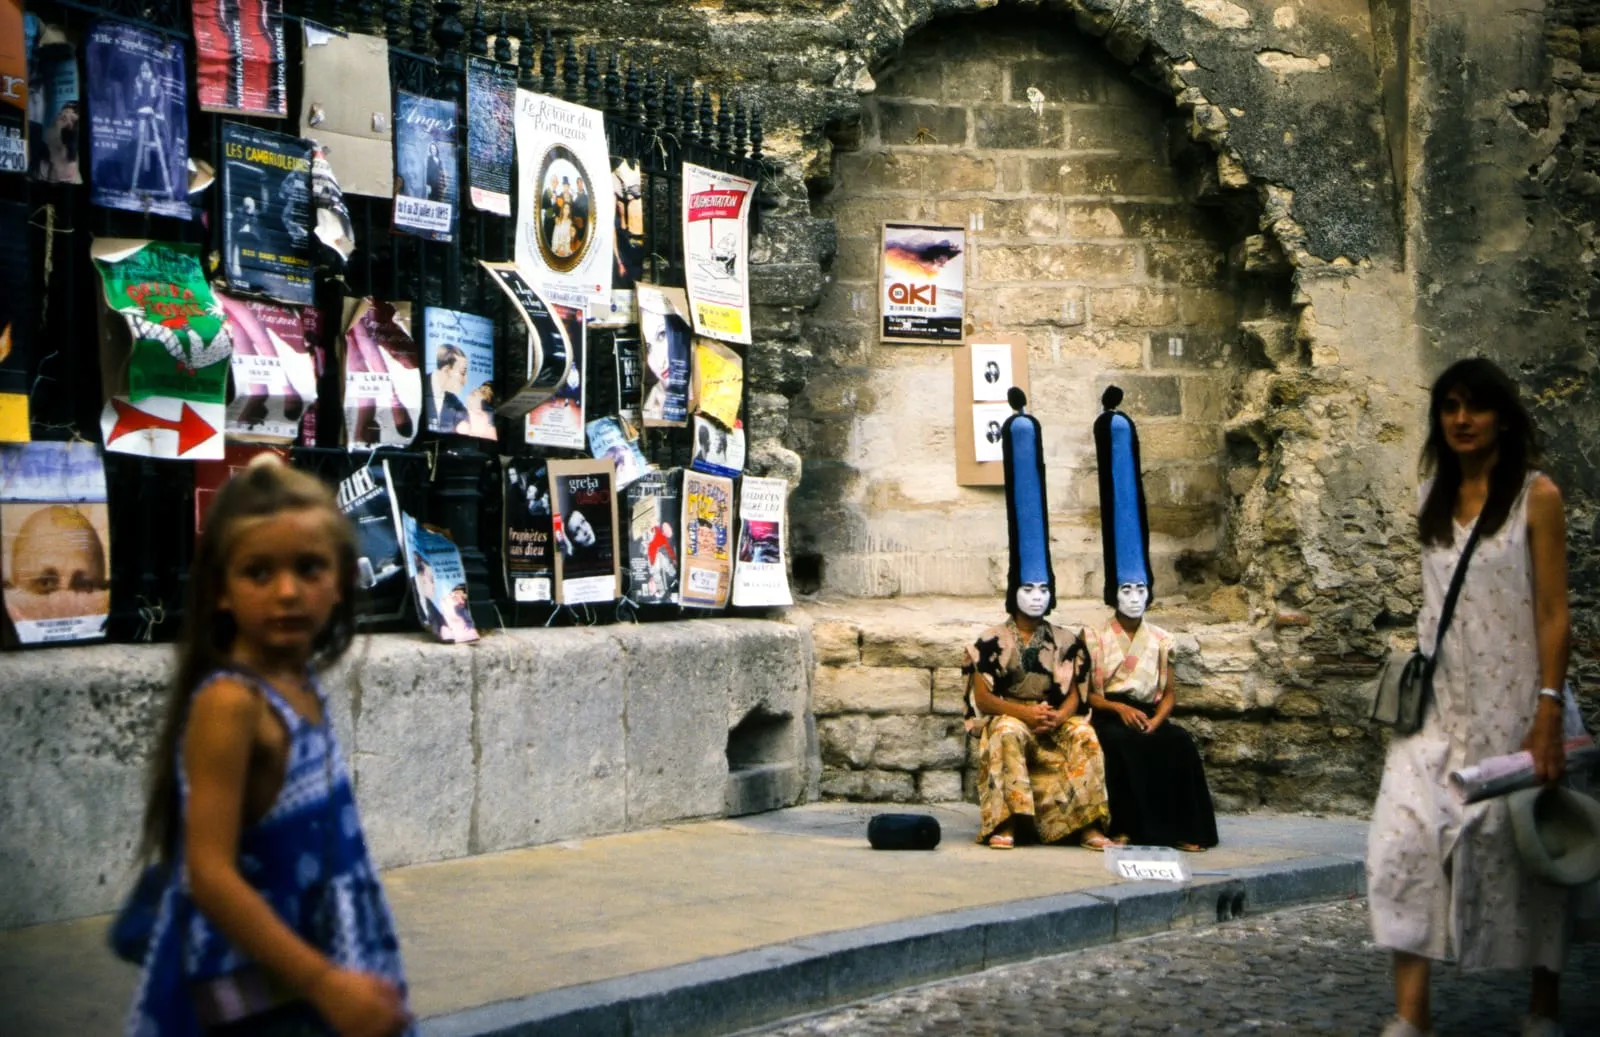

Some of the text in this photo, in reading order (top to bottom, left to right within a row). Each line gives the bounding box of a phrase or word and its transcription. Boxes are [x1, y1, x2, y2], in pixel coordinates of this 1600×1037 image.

[233, 20, 242, 56] DANCE
[275, 27, 285, 60] DANCE
[534, 114, 586, 140] Portugais
[540, 100, 575, 124] Retour
[578, 112, 592, 129] du
[225, 143, 241, 158] LES
[569, 476, 599, 496] greta
[1121, 863, 1177, 879] Merci
